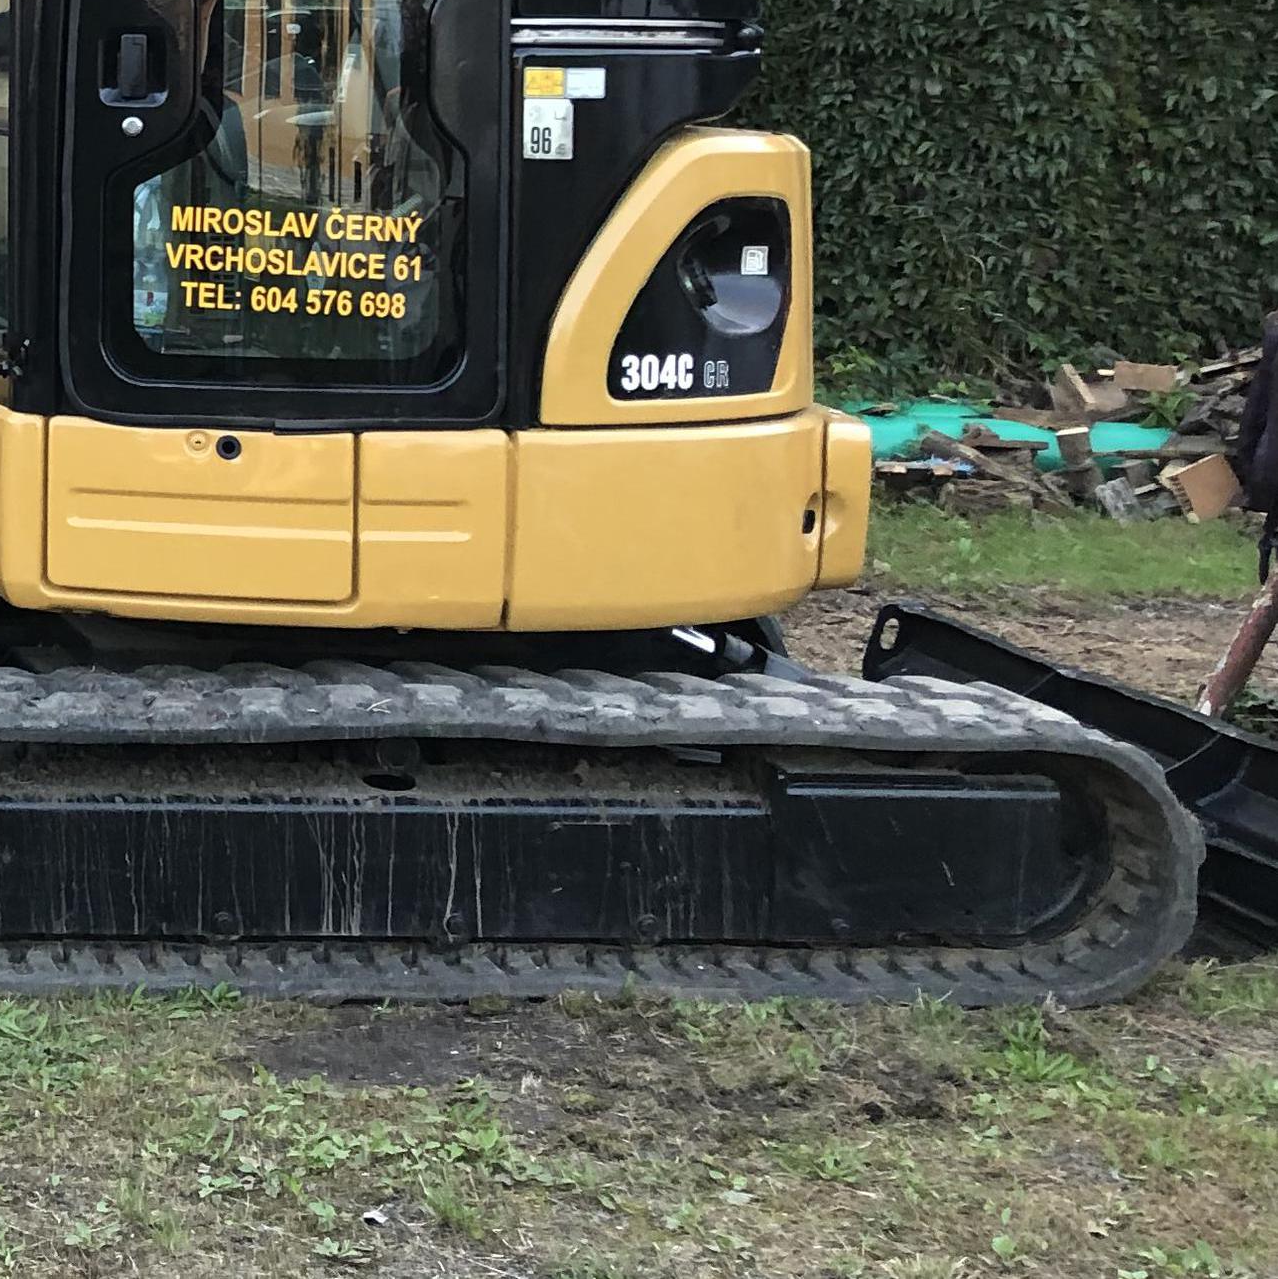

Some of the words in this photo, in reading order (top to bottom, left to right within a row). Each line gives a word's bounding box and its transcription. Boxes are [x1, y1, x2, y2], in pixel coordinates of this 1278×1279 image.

[530, 126, 552, 154] 96
[171, 205, 318, 238] MIROSLAV
[325, 207, 423, 243] ČERNÝ
[165, 242, 386, 280] VRCHOSLAVICE
[393, 255, 422, 282] 61
[180, 281, 241, 310] TEL:
[250, 285, 298, 314] 604
[305, 290, 353, 316] 576
[359, 292, 406, 319] 698
[621, 353, 694, 391] 304C
[703, 360, 730, 388] CR
